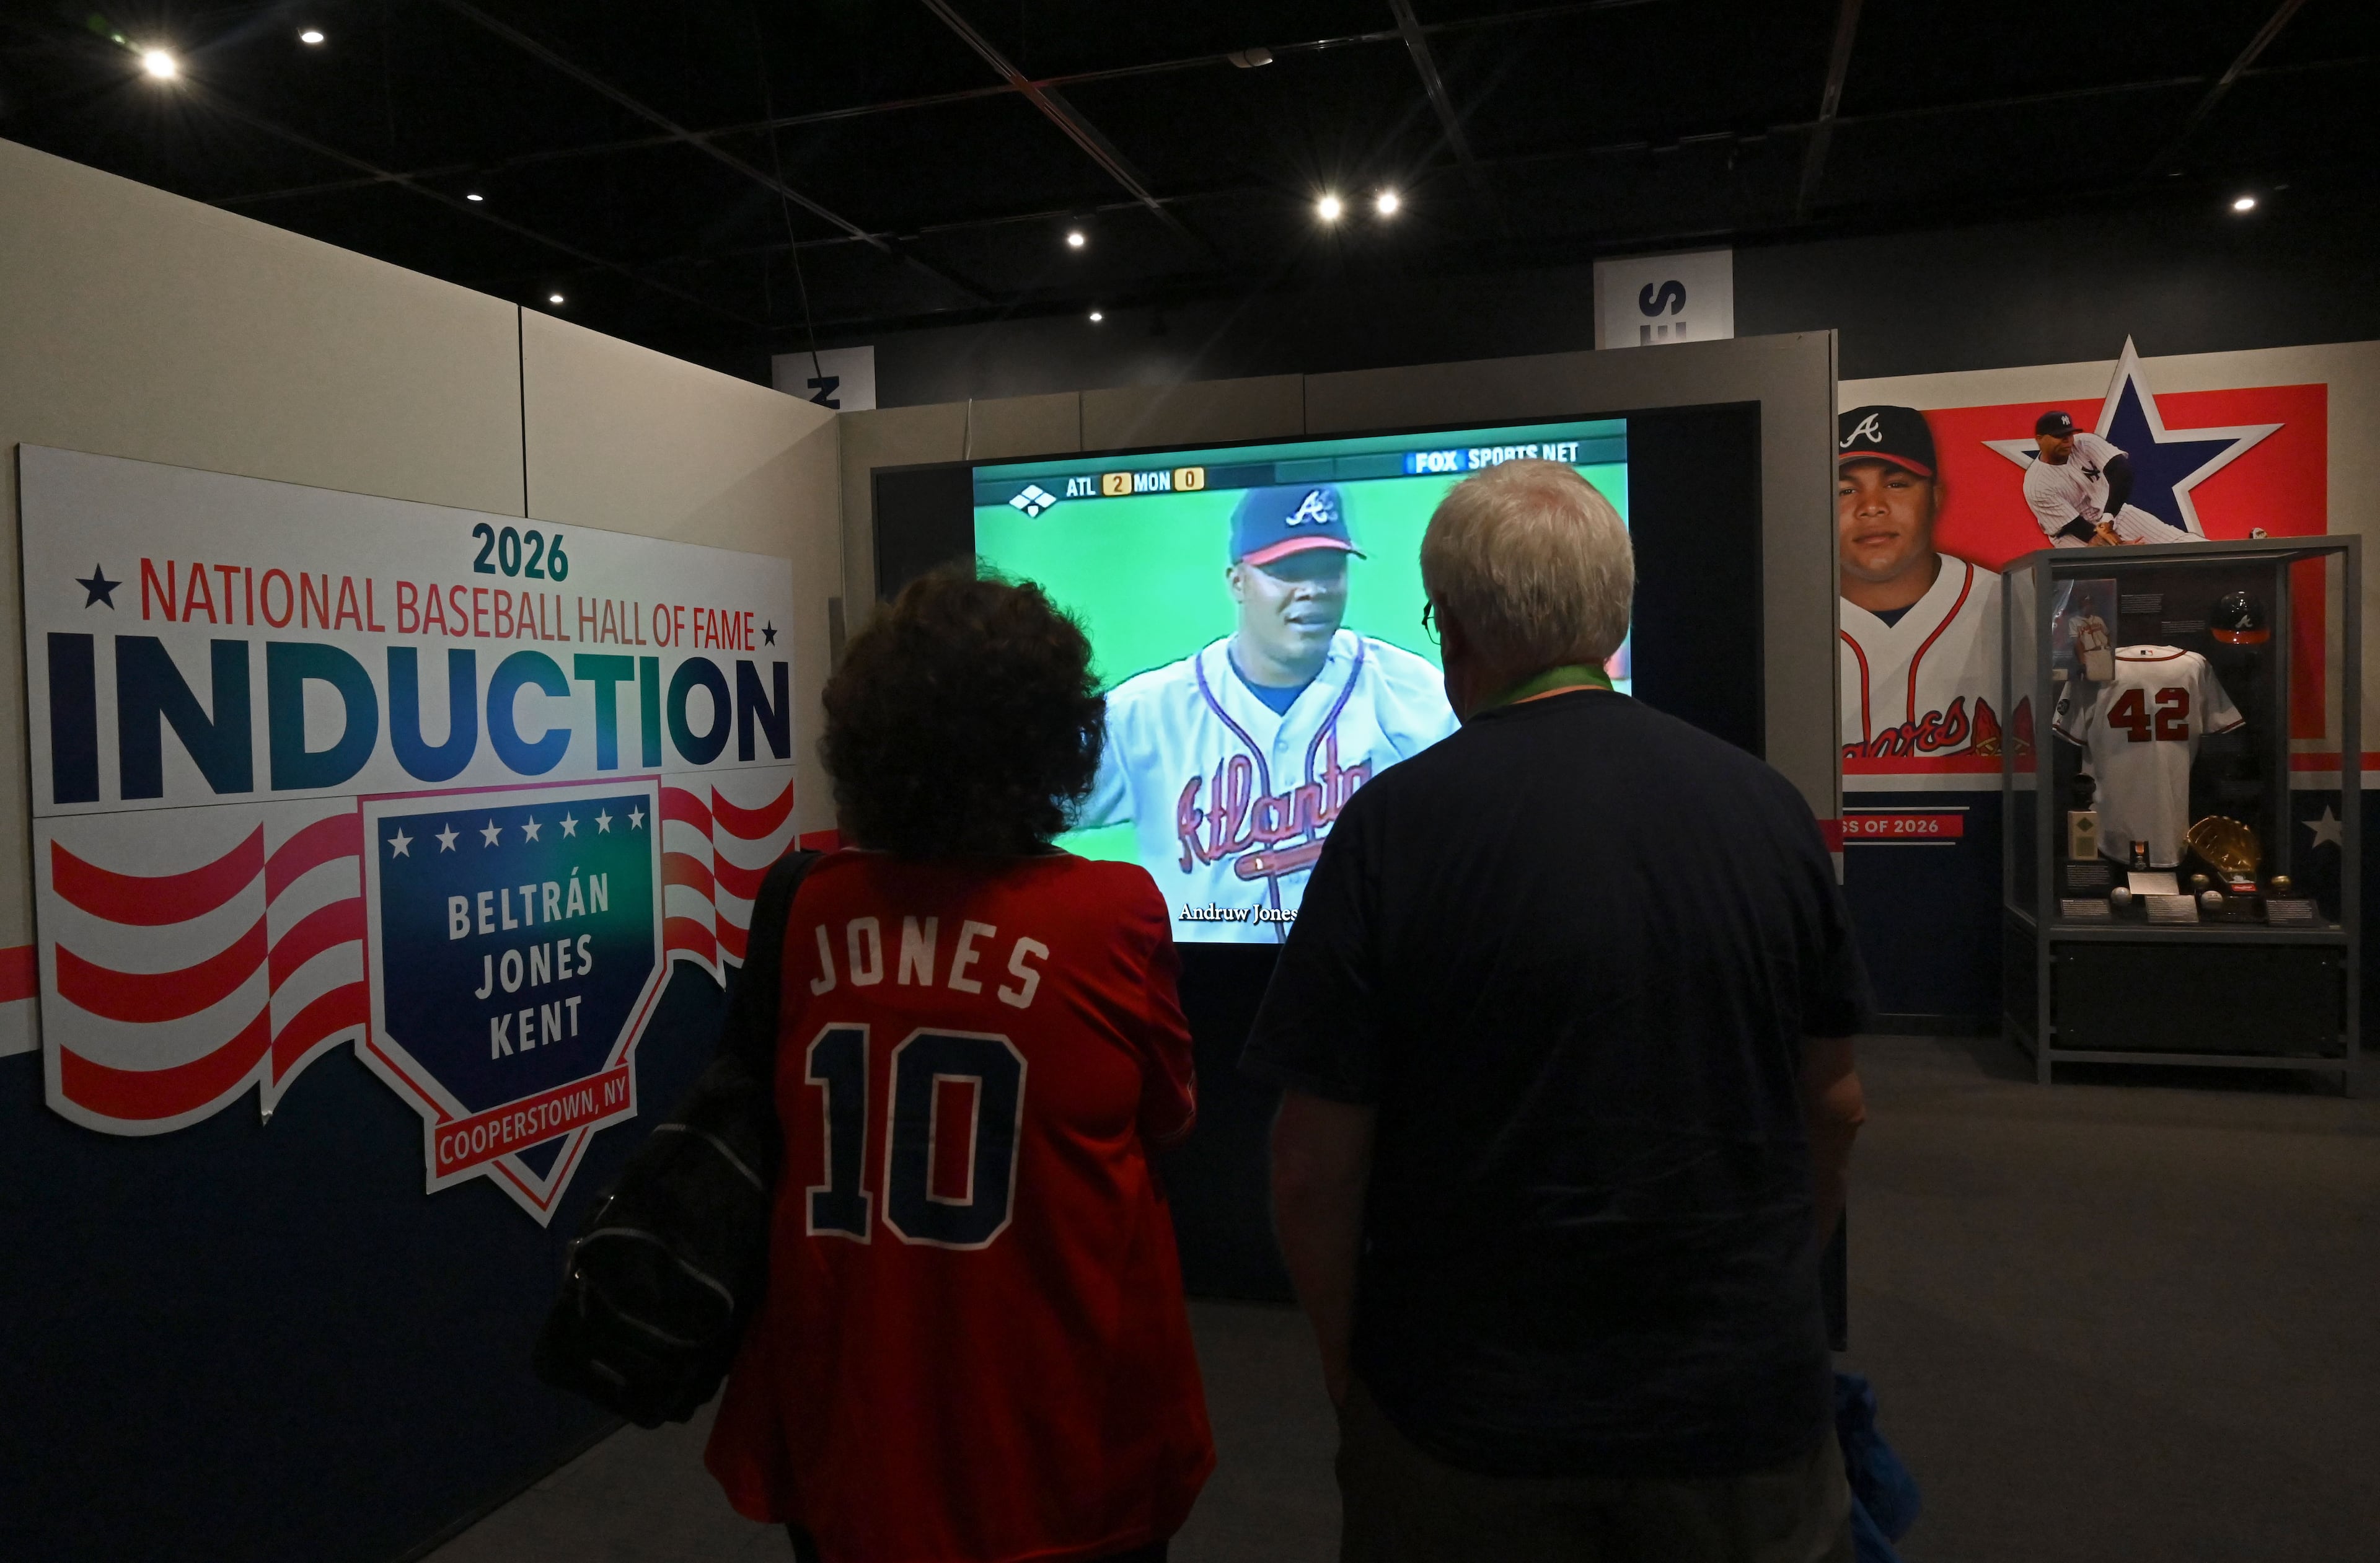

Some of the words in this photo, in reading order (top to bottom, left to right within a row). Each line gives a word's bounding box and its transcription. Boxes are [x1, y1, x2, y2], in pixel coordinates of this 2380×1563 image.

[1066, 477, 1096, 496] ATL
[1113, 475, 1122, 492] 2
[1134, 471, 1171, 492] MON
[1185, 470, 1194, 487] 0
[1415, 451, 1458, 473] FOX
[1468, 443, 1538, 470] SPORTS
[1542, 442, 1579, 462] NET
[472, 522, 568, 582] 2026
[140, 557, 386, 633] NATIONAL
[396, 580, 571, 642] BASEBALL
[578, 596, 647, 646] HALL
[653, 602, 685, 648] OF
[694, 607, 756, 651] FAME
[47, 632, 791, 804] INDUCTION
[2107, 687, 2190, 743] 42
[1865, 820, 1889, 834] OF
[1894, 819, 1939, 834] 2026
[448, 866, 609, 940] BELTRÁN
[1178, 902, 1250, 922] Andruw
[1253, 904, 1298, 925] Jones
[475, 934, 593, 1000] JONES
[809, 915, 1050, 1010] JONES
[490, 995, 582, 1060] KENT
[439, 1089, 599, 1165] COOPERSTOWN,
[604, 1076, 627, 1107] NY
[804, 1022, 1029, 1251] 10
